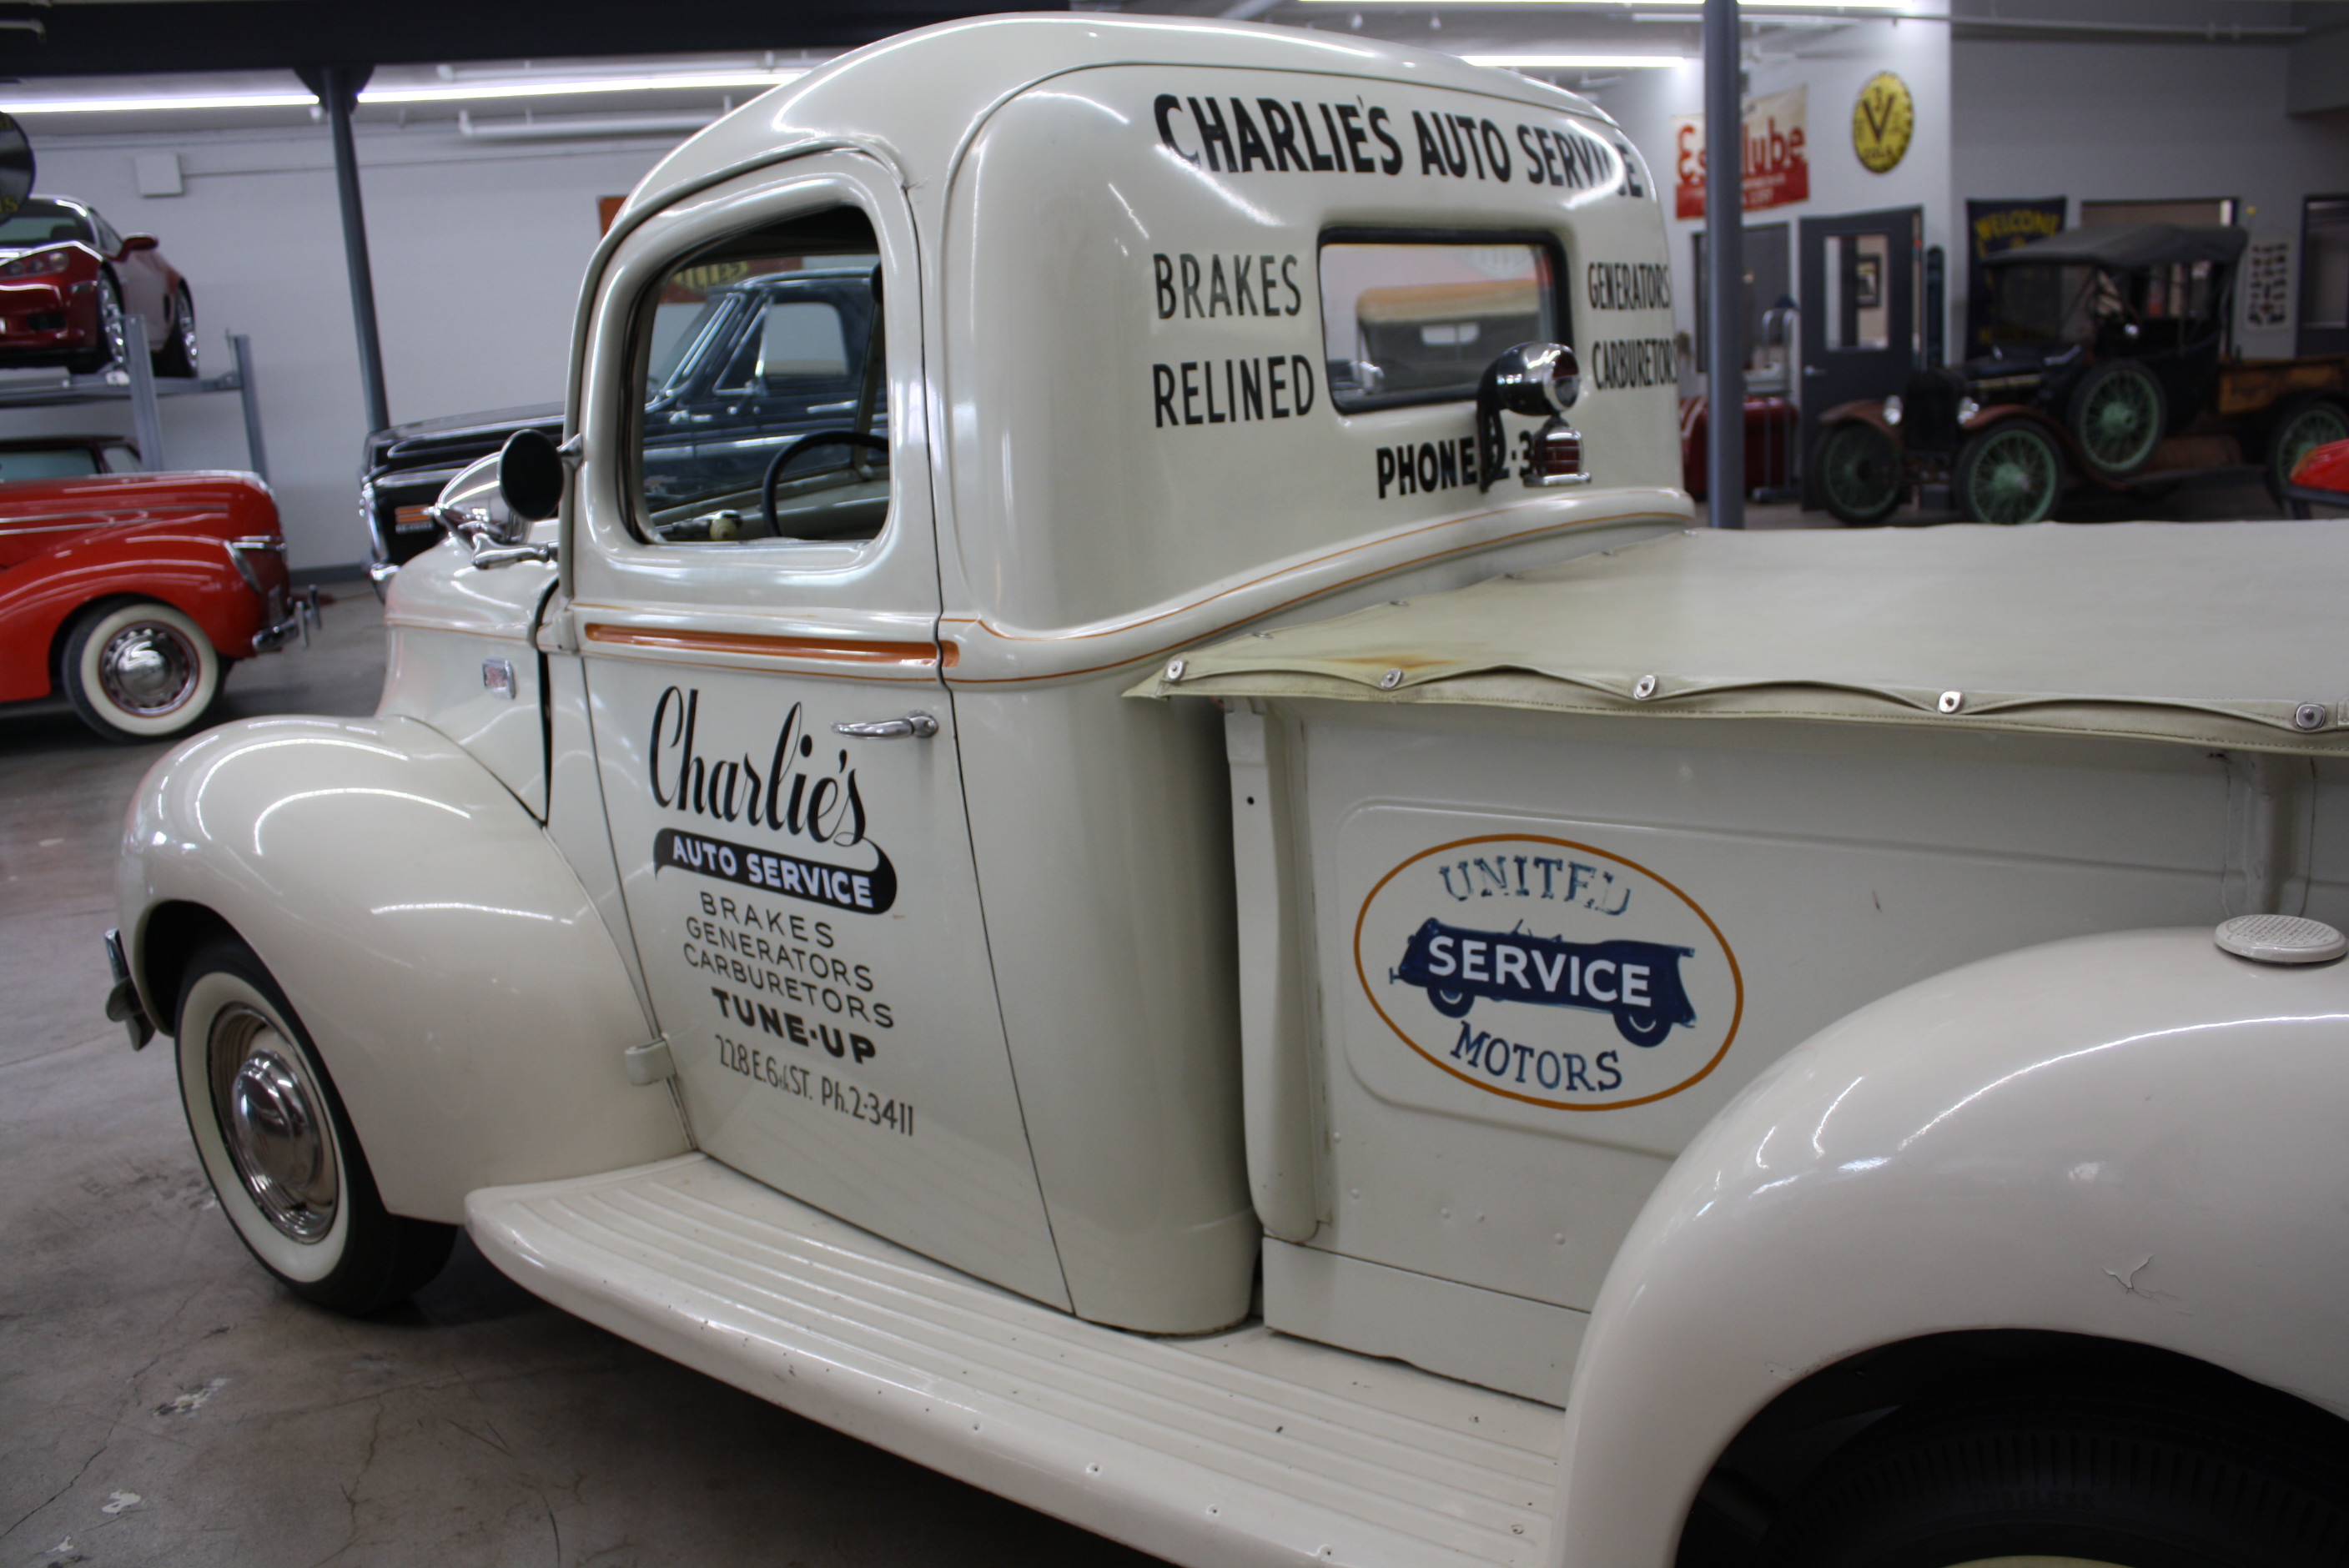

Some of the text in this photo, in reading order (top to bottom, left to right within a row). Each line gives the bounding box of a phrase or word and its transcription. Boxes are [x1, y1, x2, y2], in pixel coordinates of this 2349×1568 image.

[1154, 93, 1404, 176] CHARLIE'S
[1411, 110, 1511, 183] AUTO
[1153, 253, 1302, 319] BRAKES
[1587, 262, 1671, 310] GENERATORS
[1153, 354, 1315, 427] RELINED
[1592, 338, 1678, 390] CARBURETORS
[1376, 435, 1477, 499] PHONE
[649, 686, 866, 847] Charlie's
[672, 835, 874, 908] AUTO SERVICE
[1438, 855, 1632, 916] UNITED
[686, 917, 873, 992] GENERATORS
[700, 891, 834, 948] BRAKES
[683, 942, 894, 1028] CARBURETORS
[1428, 936, 1652, 1008] SERVICE
[711, 987, 876, 1064] TUNE-UP
[1451, 1020, 1623, 1093] MOTORS
